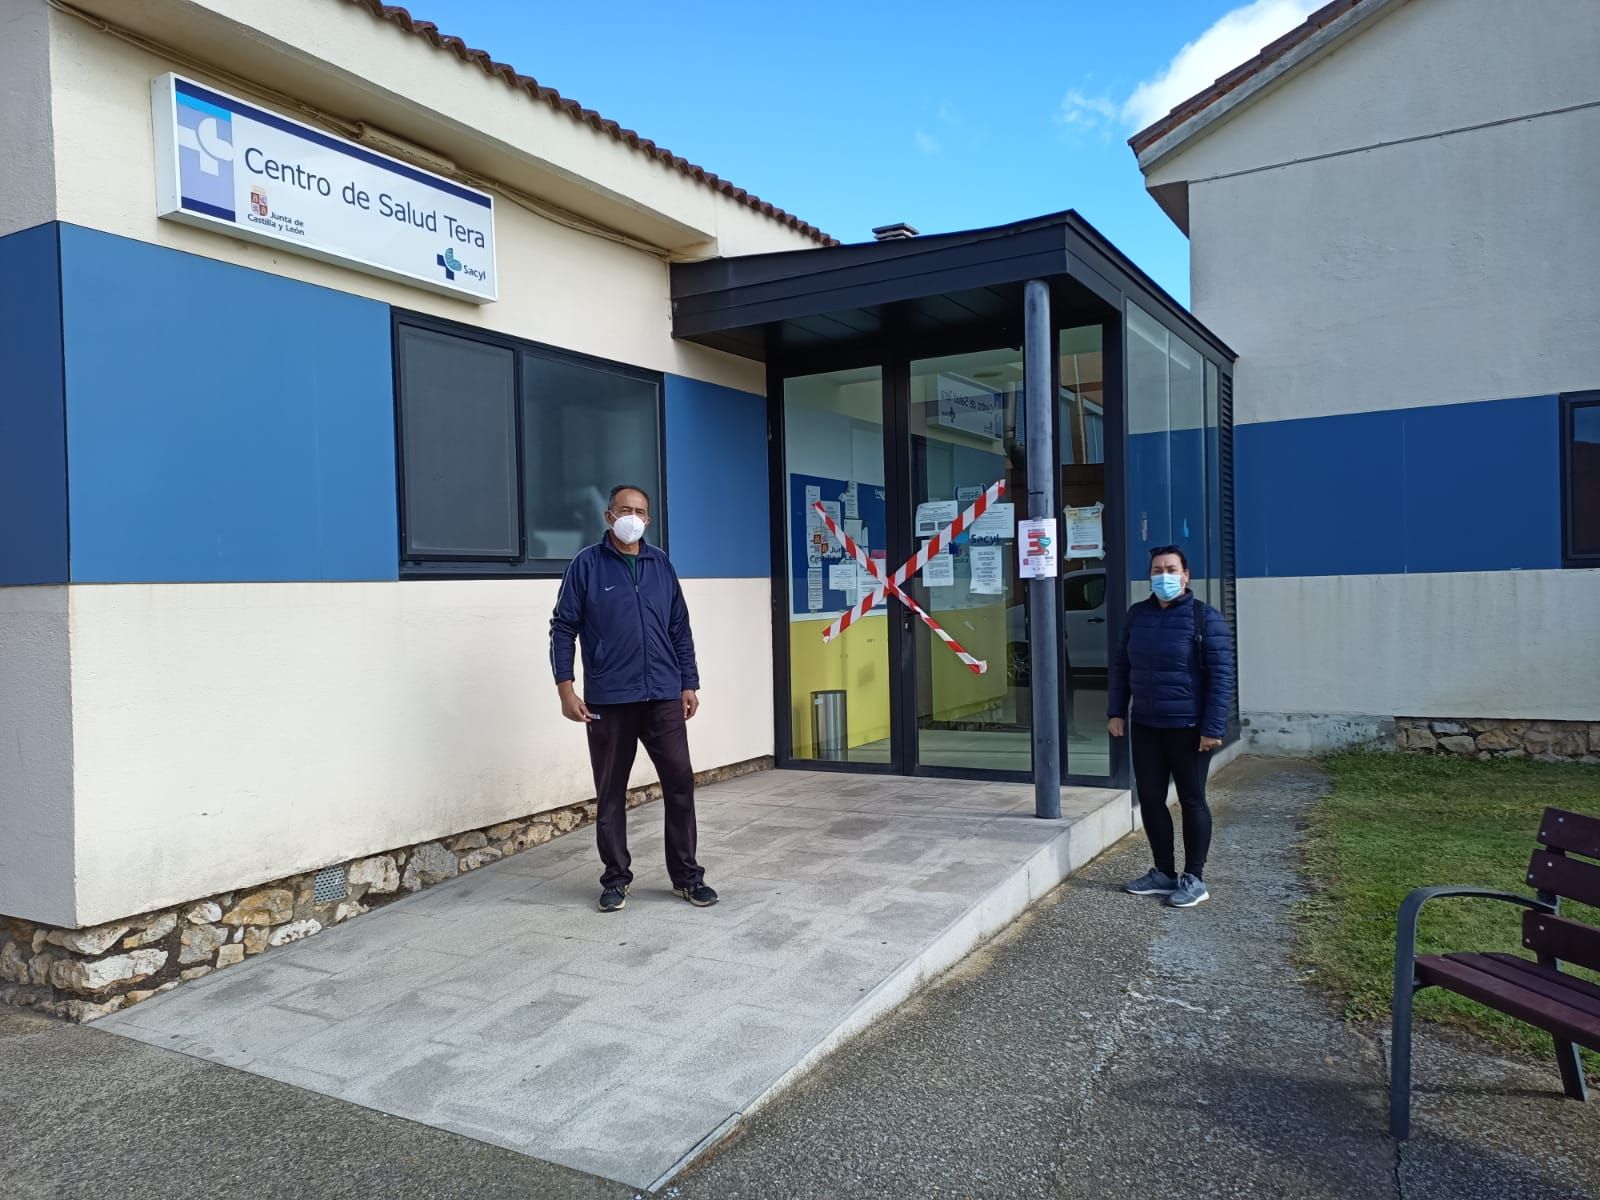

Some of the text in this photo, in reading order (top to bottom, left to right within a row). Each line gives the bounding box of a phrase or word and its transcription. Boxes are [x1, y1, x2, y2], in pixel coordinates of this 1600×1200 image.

[245, 147, 485, 249] Centro de Salud Tera
[247, 213, 305, 236] Castilla y León
[270, 211, 304, 227] Junta de
[463, 264, 486, 281] Sacyl
[970, 533, 1000, 546] Sacyl
